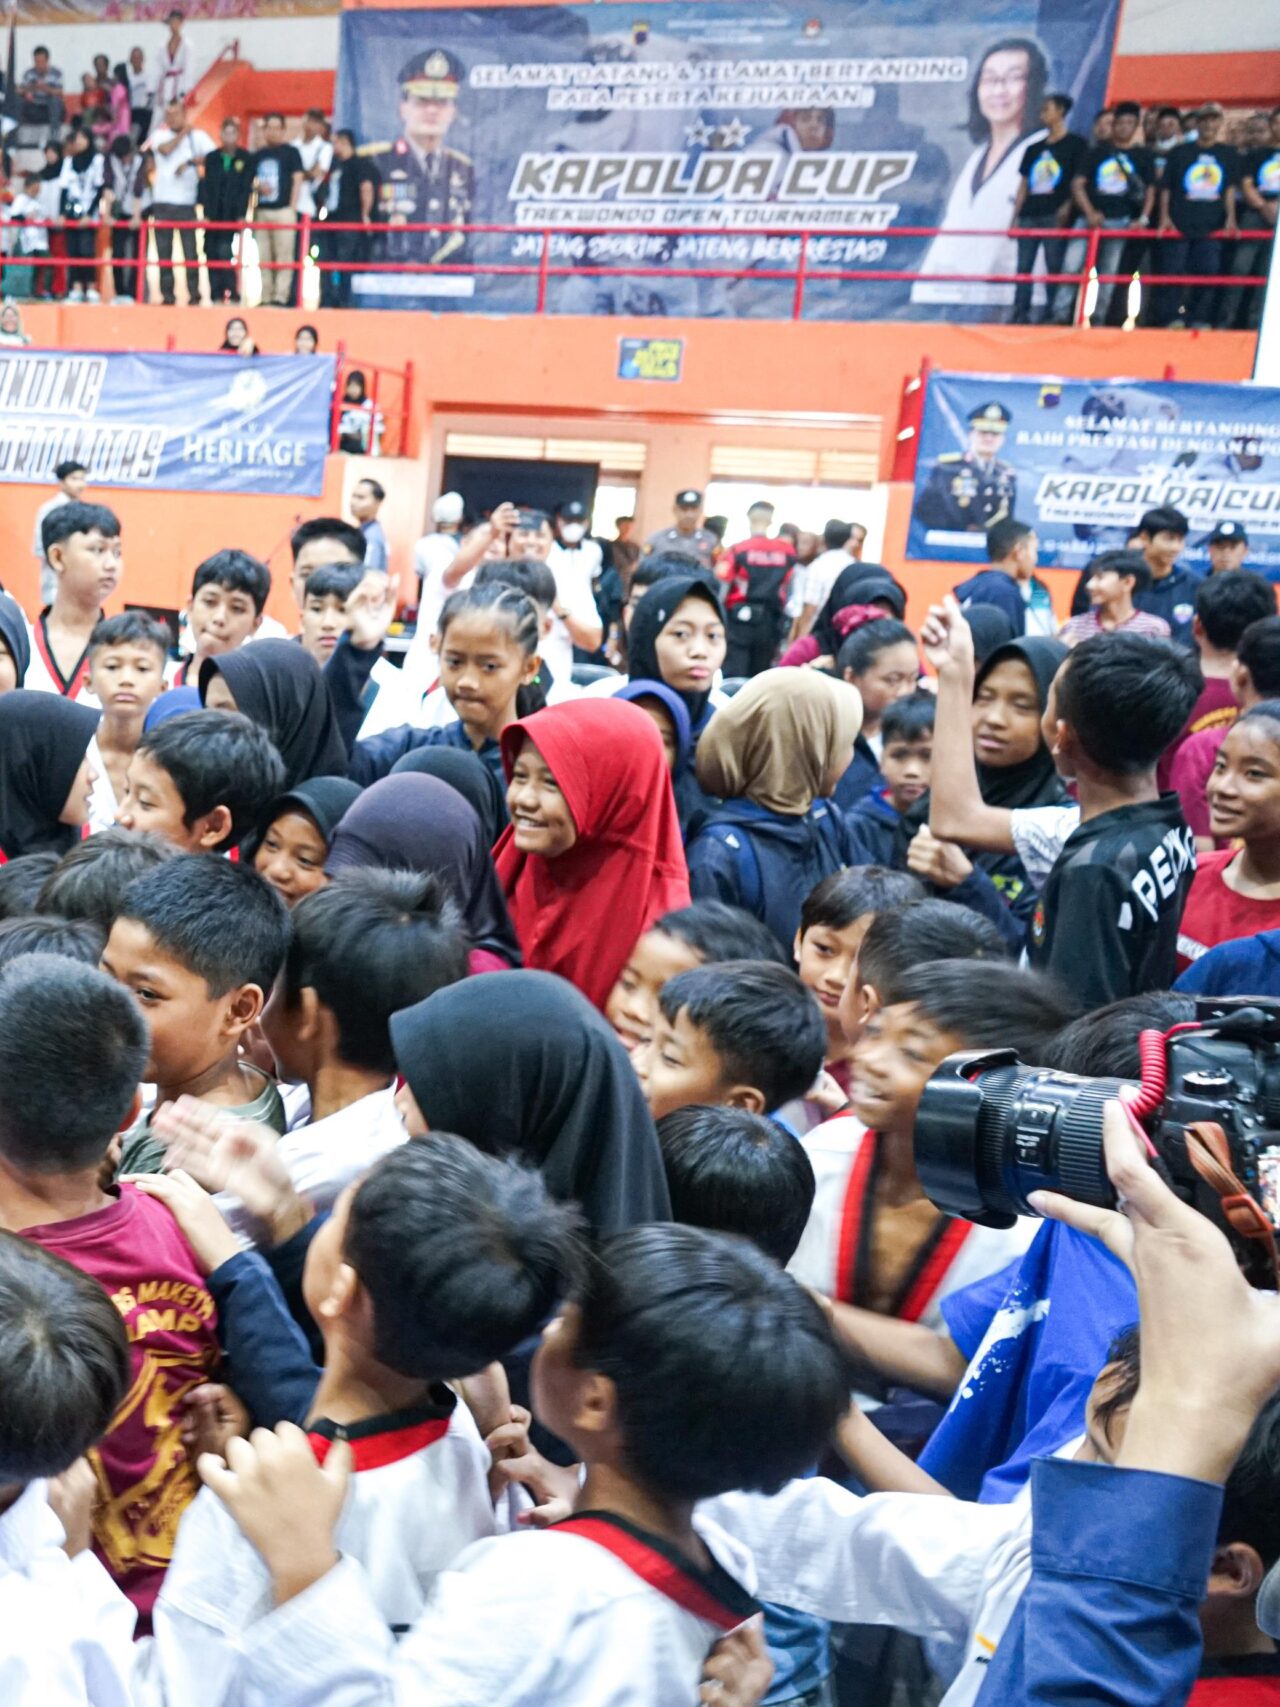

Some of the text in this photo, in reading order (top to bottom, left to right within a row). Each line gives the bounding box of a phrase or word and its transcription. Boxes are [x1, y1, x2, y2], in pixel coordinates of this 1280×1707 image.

[513, 157, 913, 197] KAPOLDA CUP
[521, 206, 891, 227] TAEKWONDO OPEN TOURNAMENT
[182, 434, 307, 467] HERITAGE
[1041, 477, 1215, 511] KAPOLDA
